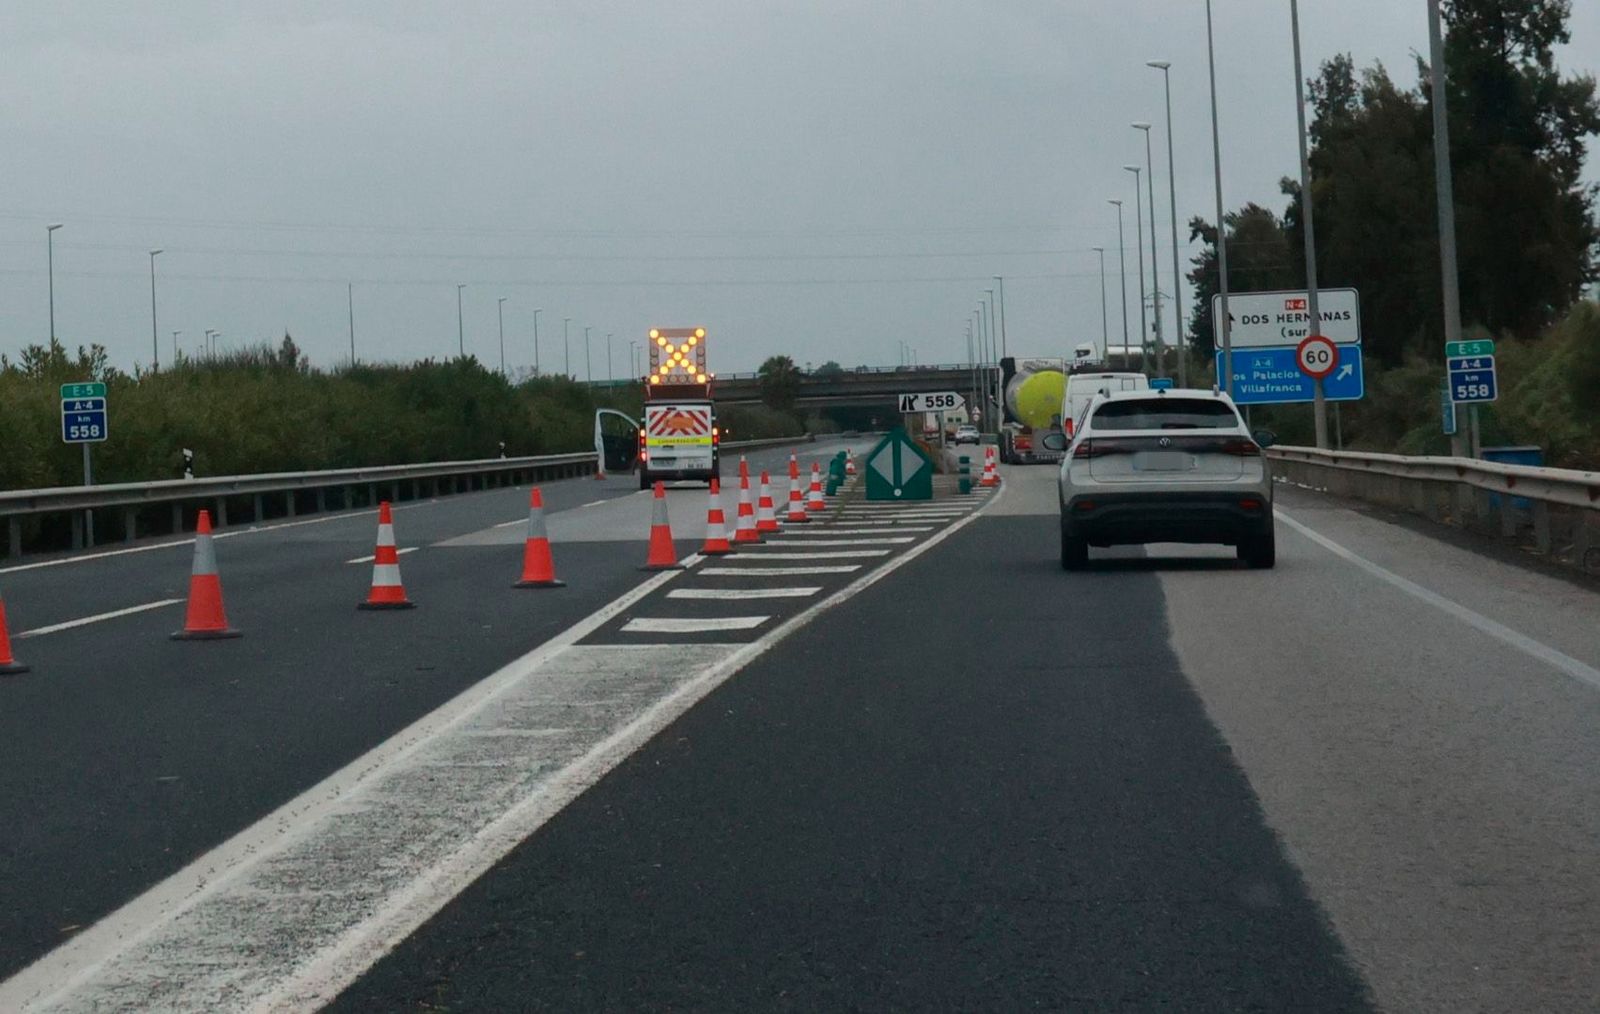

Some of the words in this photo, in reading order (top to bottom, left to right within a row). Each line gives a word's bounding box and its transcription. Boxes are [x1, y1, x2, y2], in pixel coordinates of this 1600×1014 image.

[1286, 300, 1306, 310] N-4
[1242, 314, 1269, 325] DOS
[1281, 327, 1311, 338] (sur
[1458, 343, 1481, 355] E-5
[1306, 350, 1329, 364] 60
[1254, 359, 1272, 368] A-4
[1461, 359, 1481, 369] A-4
[1253, 370, 1301, 380] Palacios
[1465, 374, 1479, 382] km
[72, 385, 94, 396] E-5
[1240, 384, 1302, 394] Villafranca
[1457, 384, 1489, 399] 558
[74, 400, 94, 410] A-4
[925, 394, 955, 408] 558
[77, 415, 91, 423] km
[70, 424, 100, 438] 558
